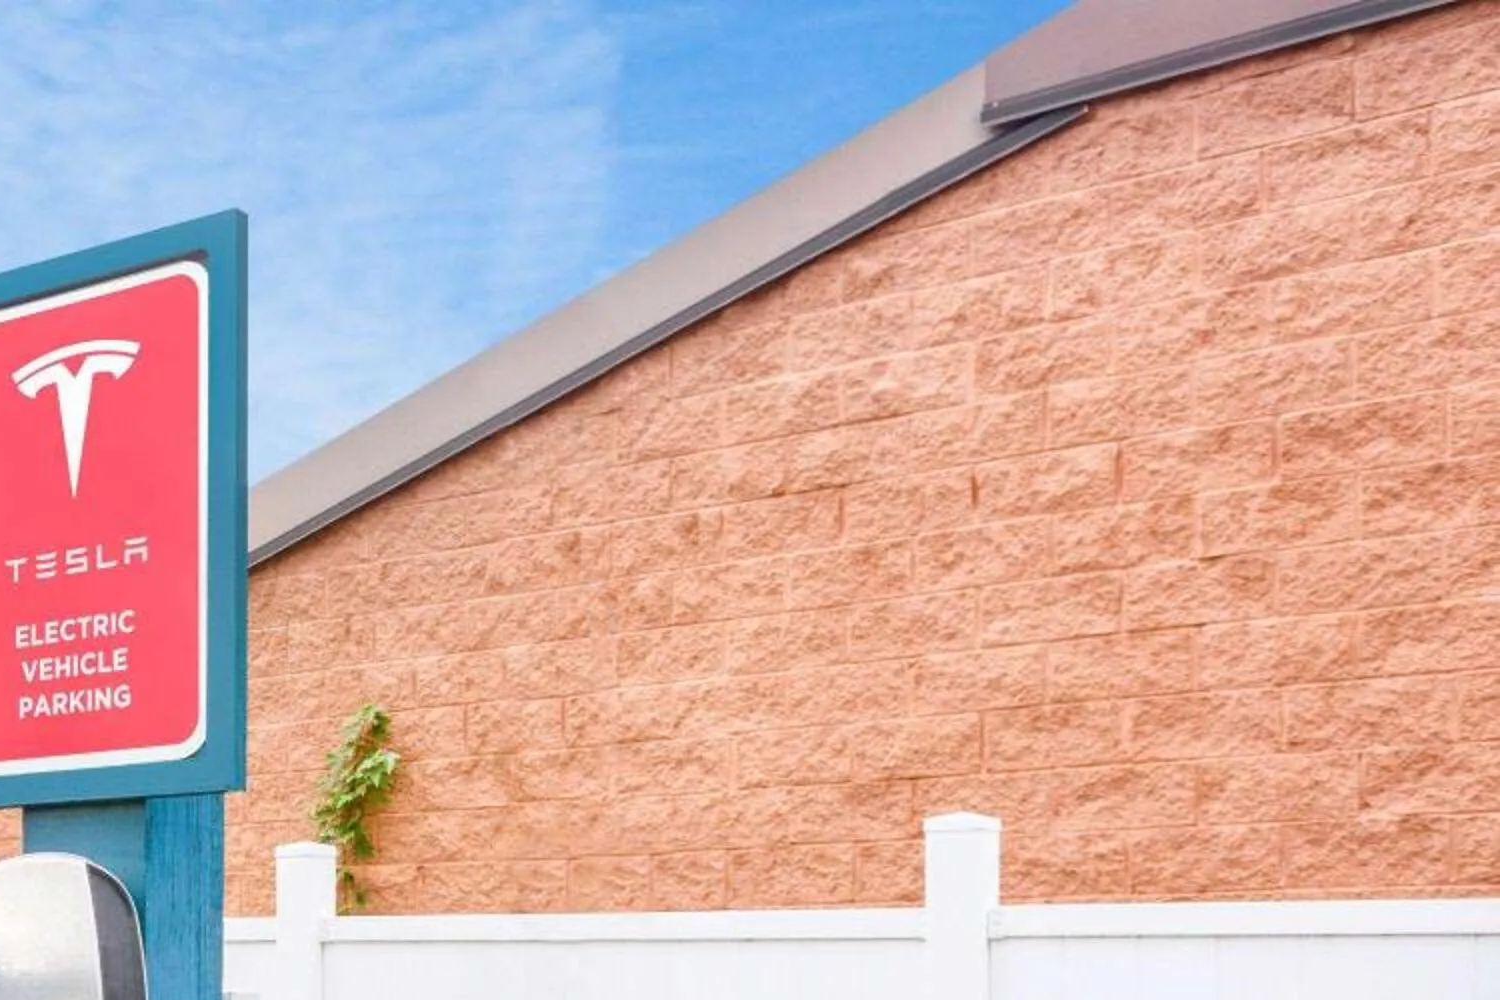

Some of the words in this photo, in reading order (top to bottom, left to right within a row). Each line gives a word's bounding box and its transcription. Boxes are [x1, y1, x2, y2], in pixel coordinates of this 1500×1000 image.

[5, 536, 149, 584] TESLA
[15, 609, 136, 649] ELECTRIC
[21, 647, 129, 683] VEHICLE
[18, 683, 132, 719] PARKING
